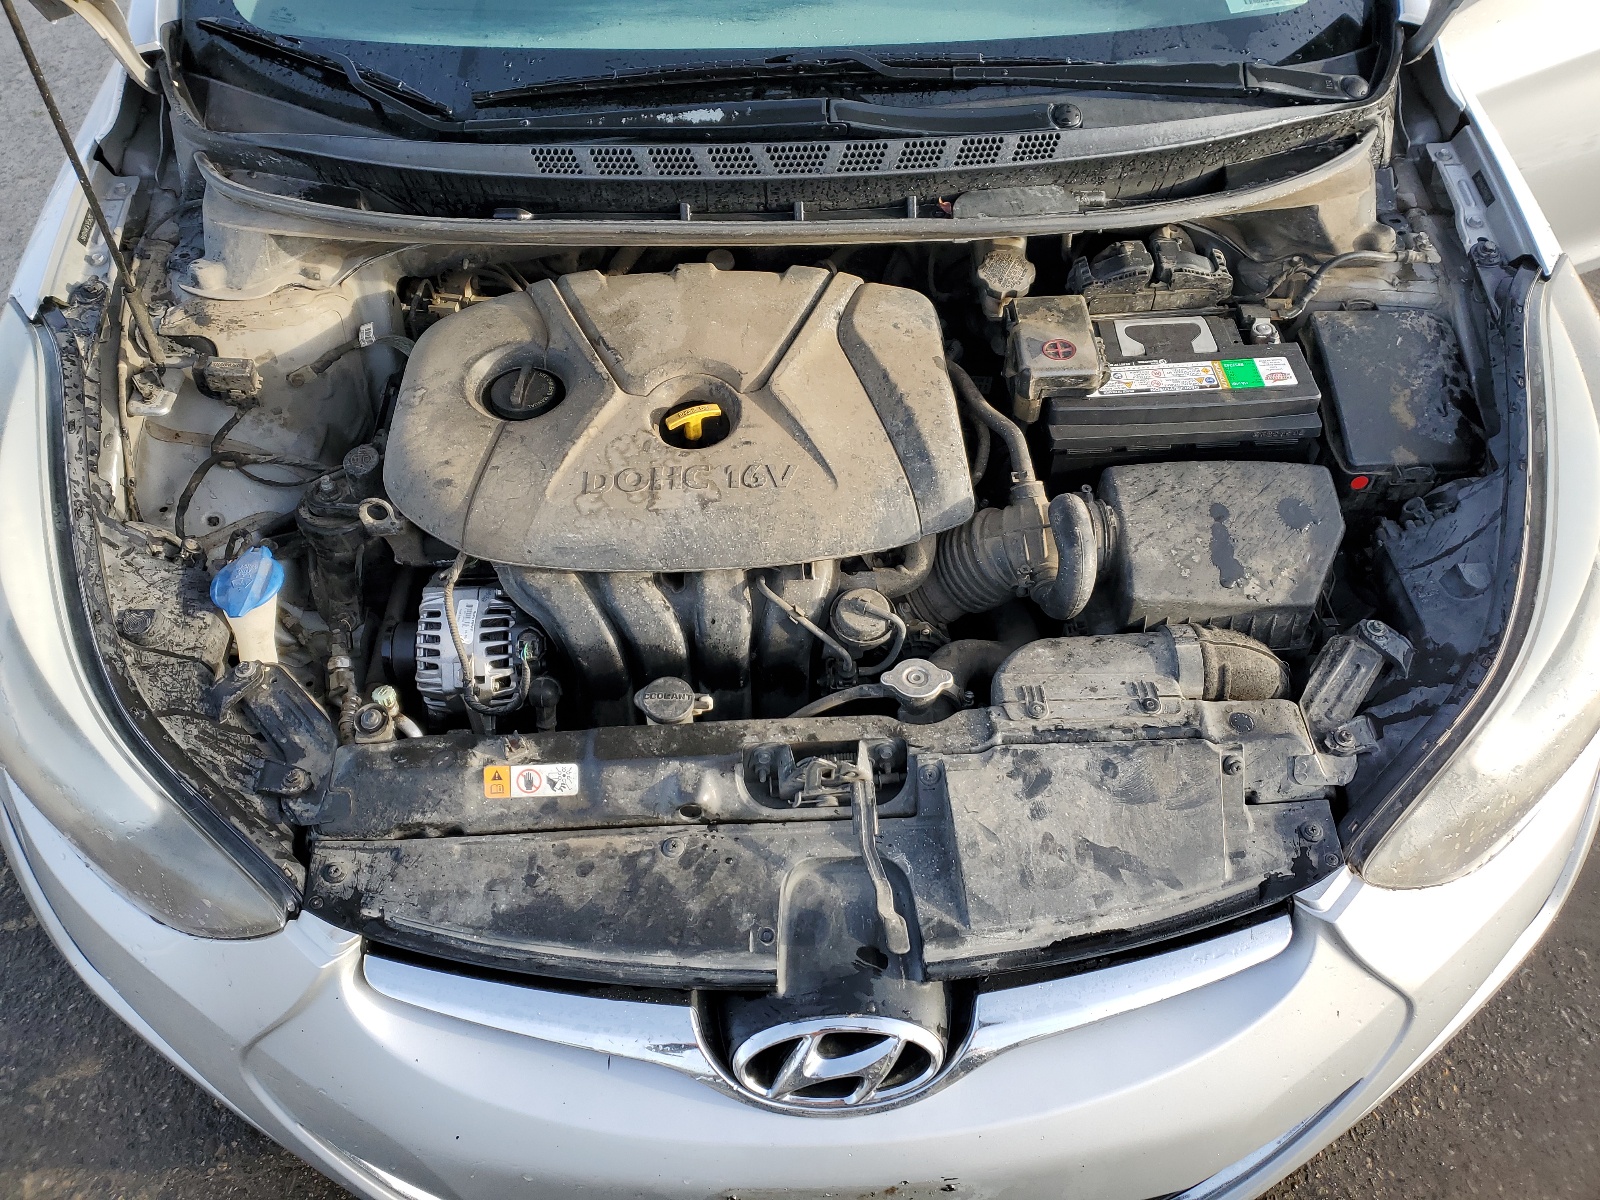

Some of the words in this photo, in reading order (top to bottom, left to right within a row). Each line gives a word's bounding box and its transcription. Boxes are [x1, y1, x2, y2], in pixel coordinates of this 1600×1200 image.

[580, 464, 713, 495] DOHC
[723, 463, 799, 489] 16V
[644, 691, 693, 701] COOLANT
